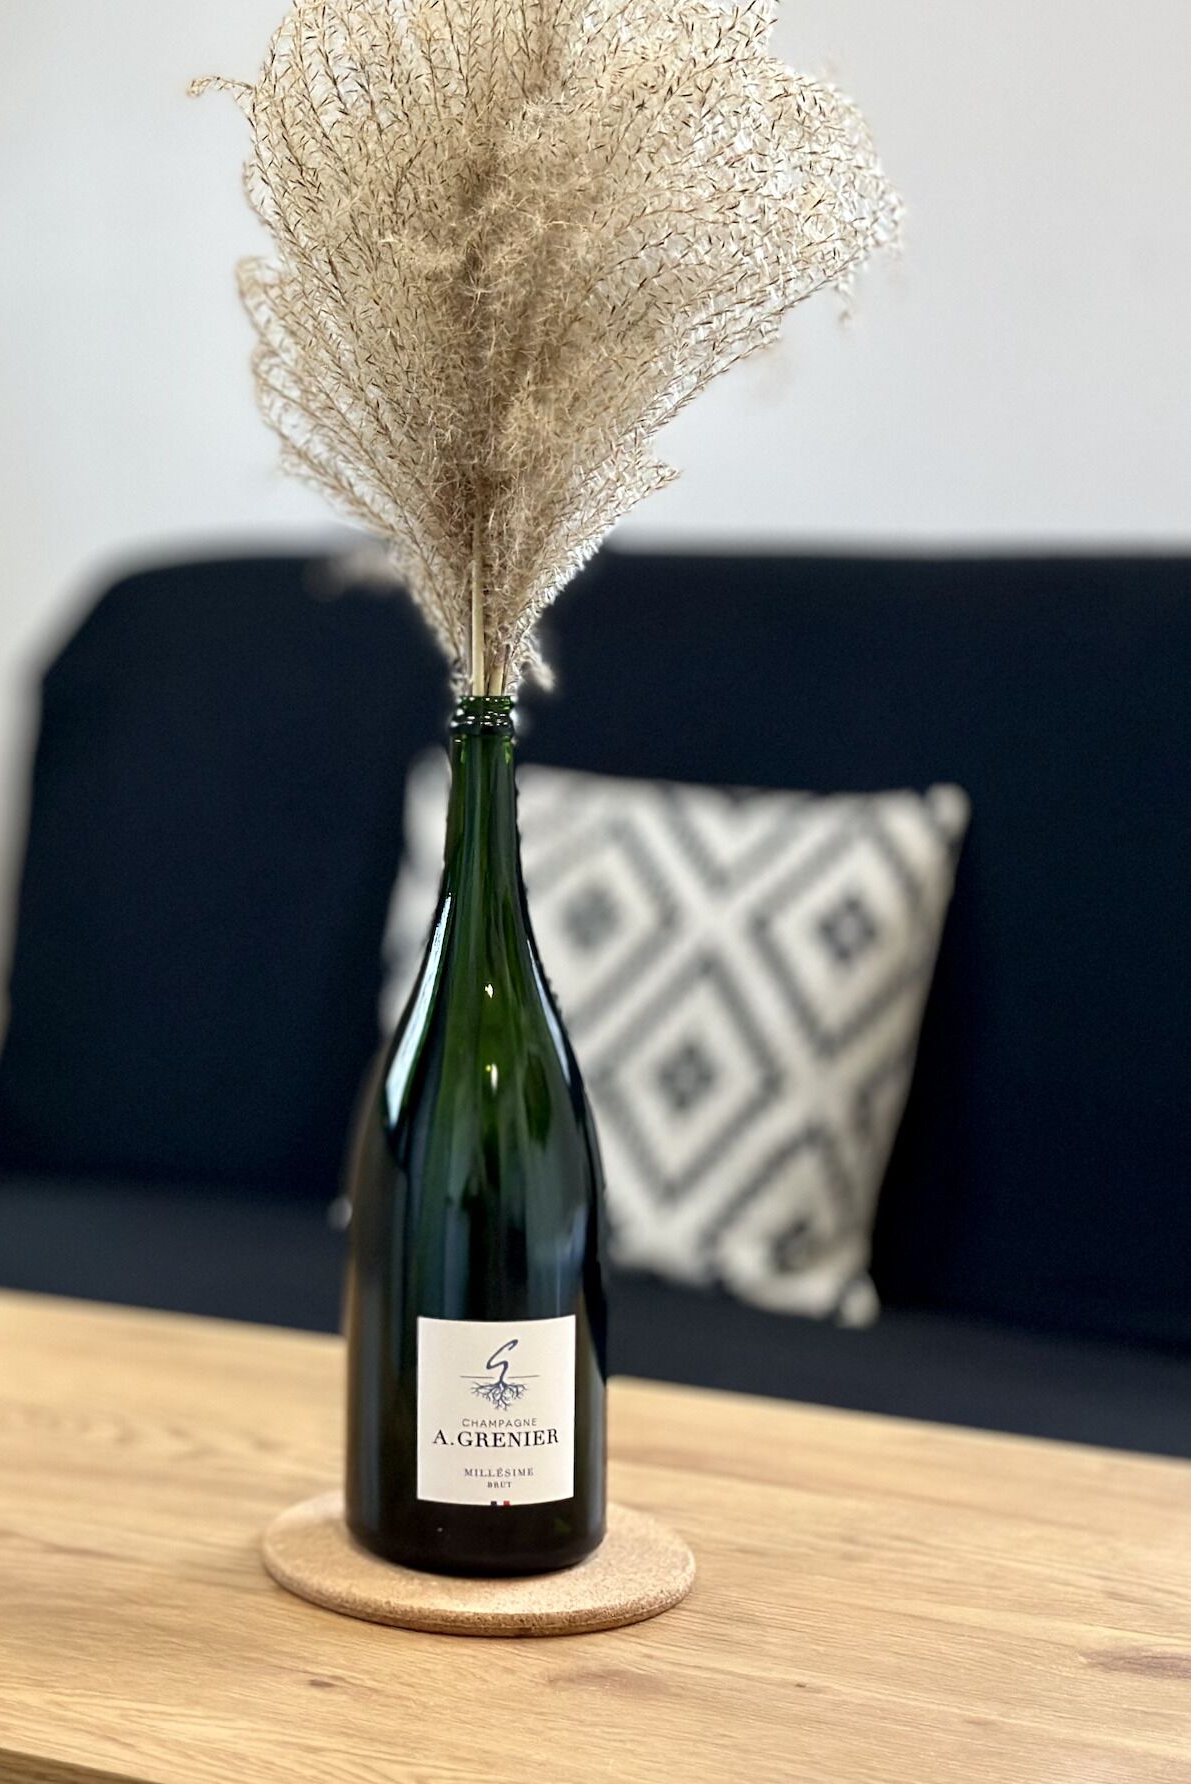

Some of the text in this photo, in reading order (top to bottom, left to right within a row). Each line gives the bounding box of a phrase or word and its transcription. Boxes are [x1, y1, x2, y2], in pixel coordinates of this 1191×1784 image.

[461, 1417, 538, 1428] CHAMPAGNE
[464, 1467, 535, 1478] MILLÉSIME
[487, 1481, 512, 1489] BRUT
